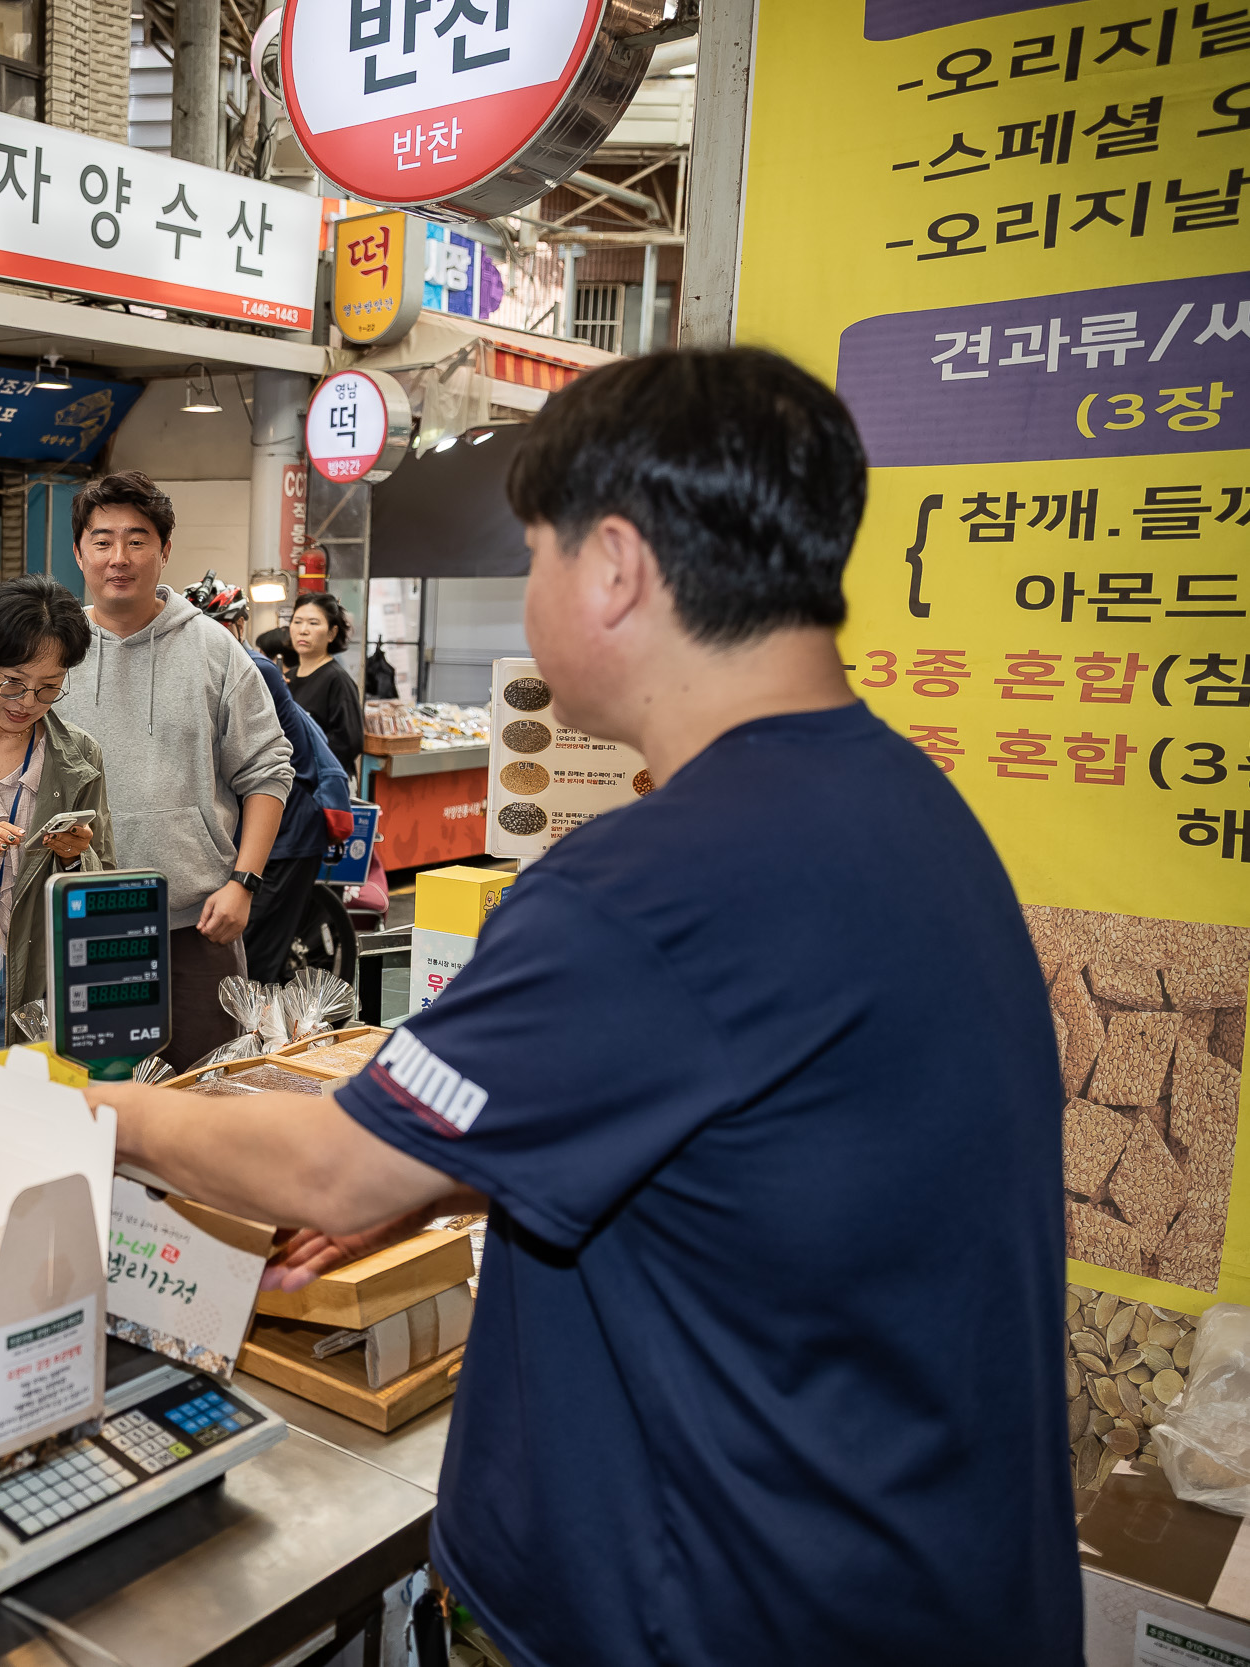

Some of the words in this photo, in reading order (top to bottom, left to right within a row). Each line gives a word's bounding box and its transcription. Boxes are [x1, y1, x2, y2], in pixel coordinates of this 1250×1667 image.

[392, 117, 463, 172] 반찬
[347, 226, 390, 291] 떡
[240, 299, 299, 325] T.446-1443
[343, 297, 394, 317] 영남방앗간
[334, 382, 358, 400] 영남
[330, 403, 357, 448] 떡
[327, 459, 362, 477] 방앗간
[283, 470, 307, 498] CC
[1014, 571, 1248, 624] 아몬드
[130, 1027, 160, 1042] CAS
[376, 1025, 489, 1133] PUMA
